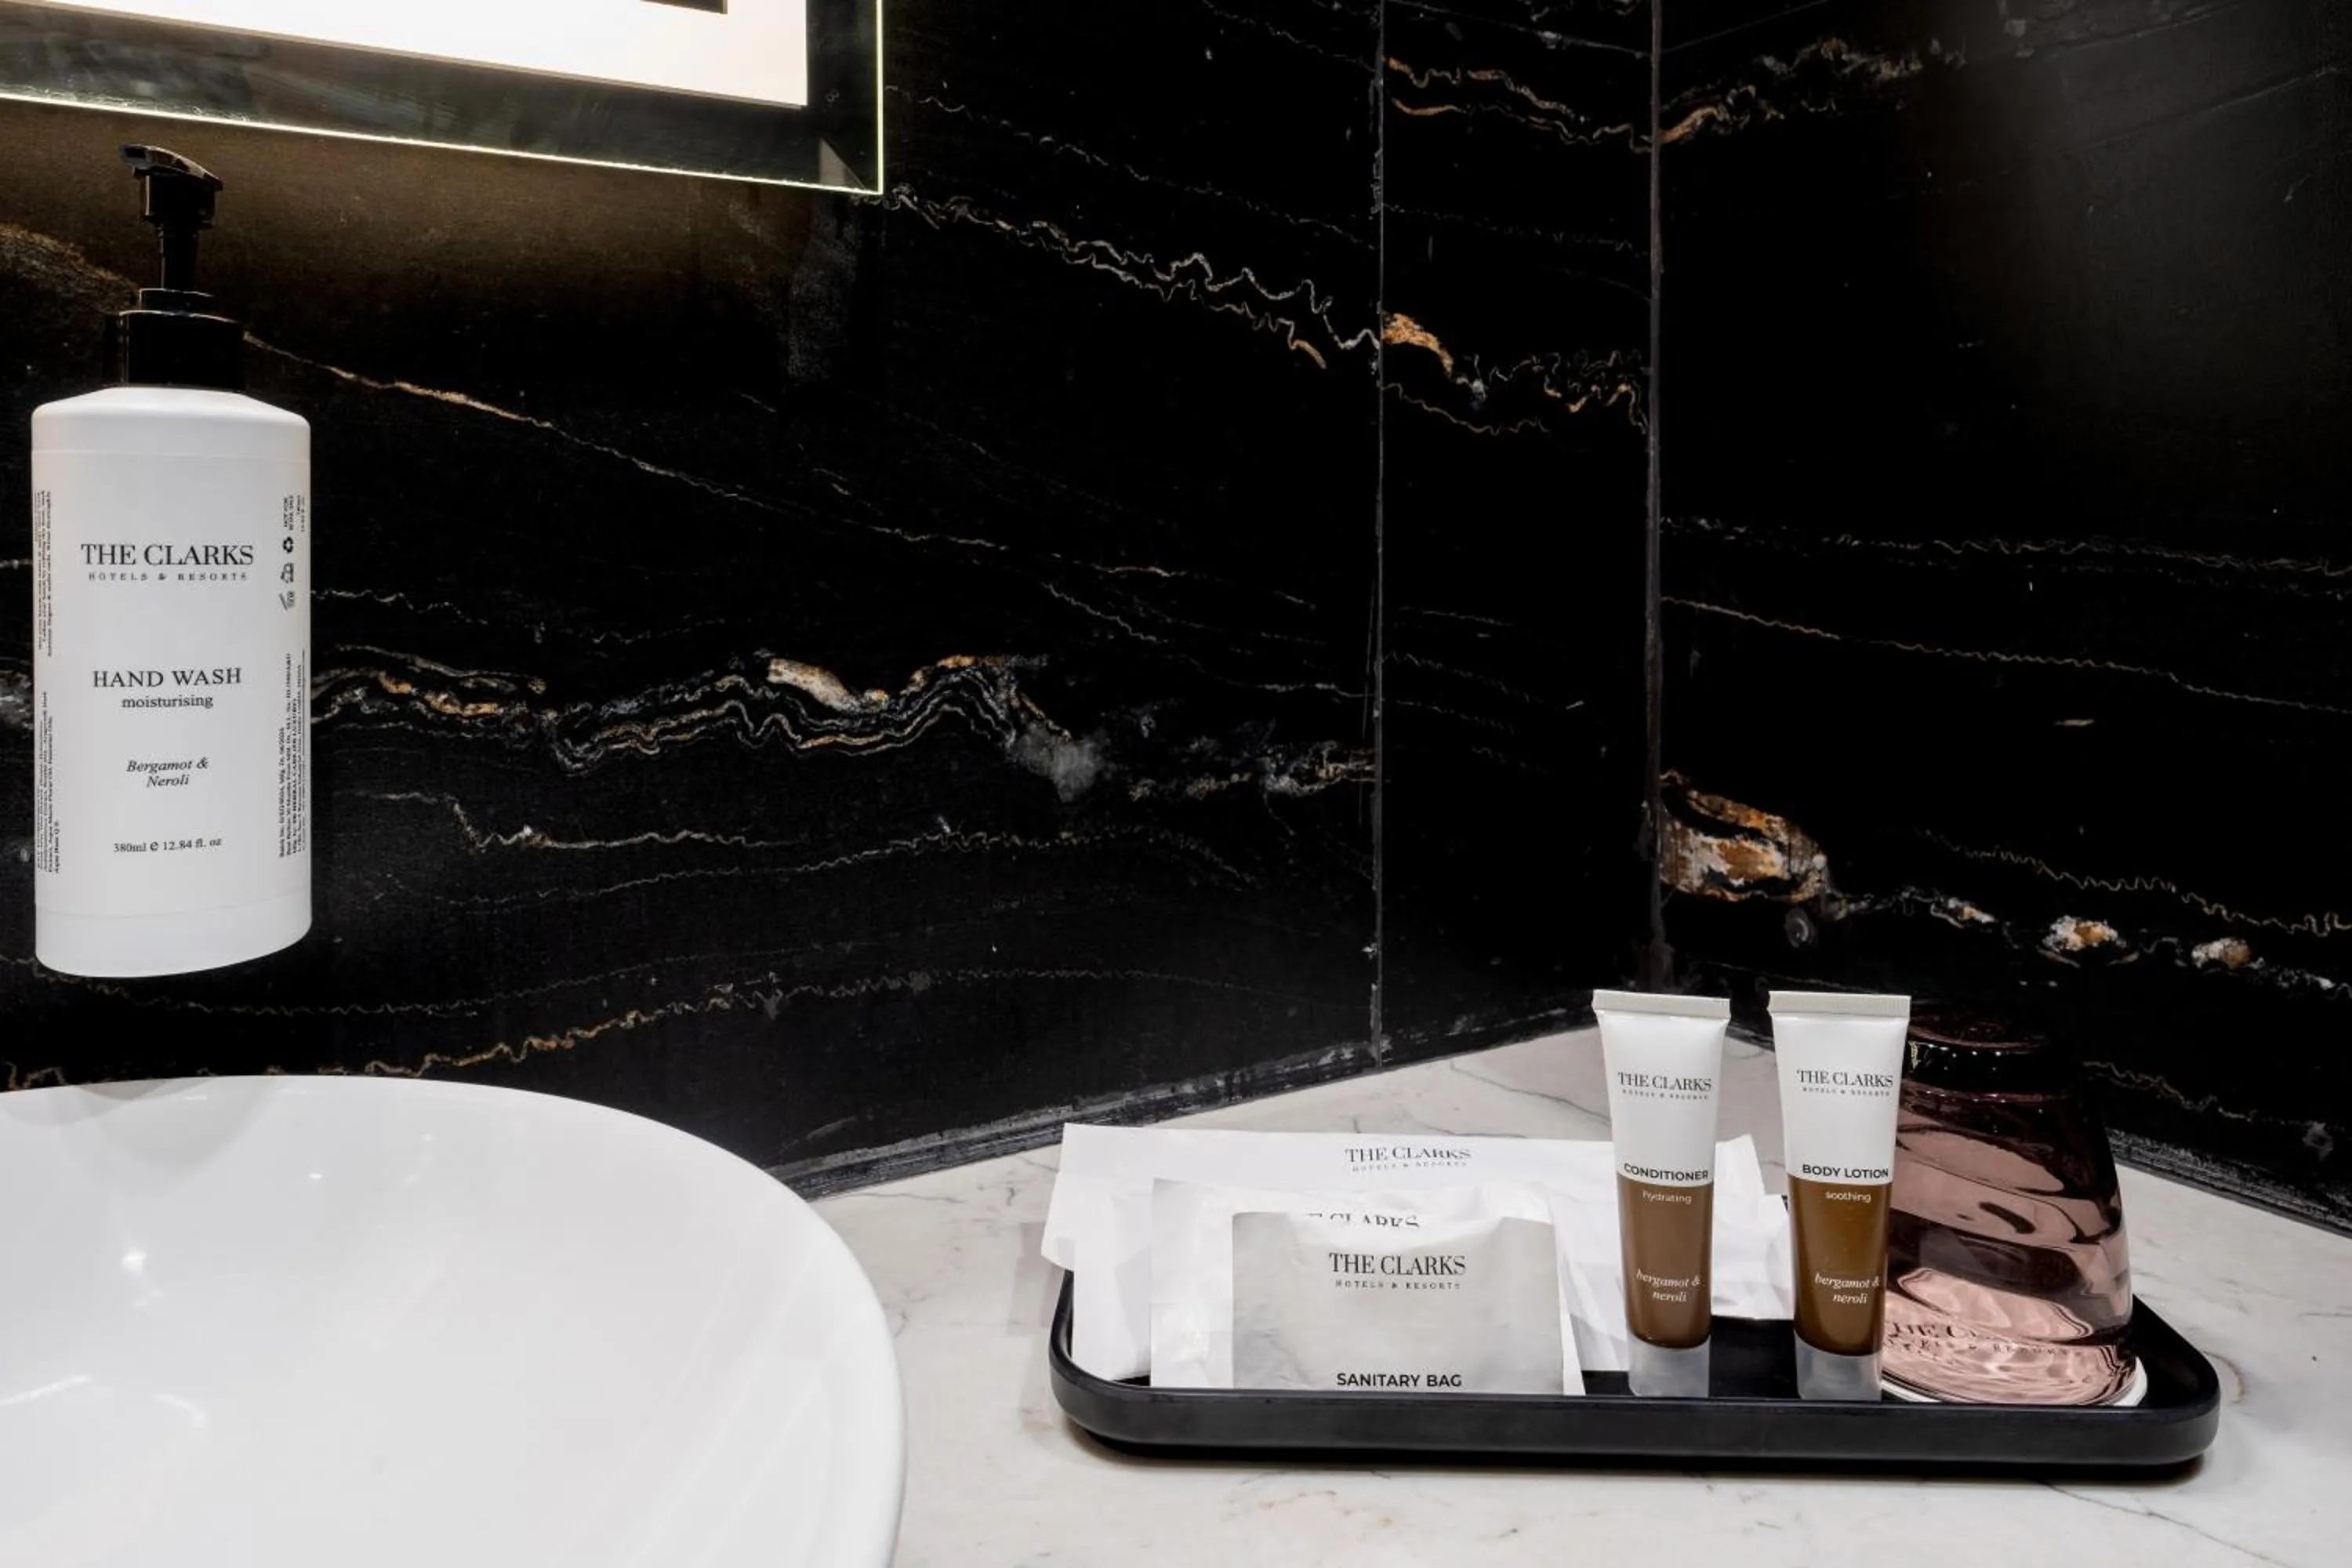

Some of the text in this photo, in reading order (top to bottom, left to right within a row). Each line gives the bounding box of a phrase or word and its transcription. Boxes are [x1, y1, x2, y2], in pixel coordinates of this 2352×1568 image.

[81, 543, 254, 566] THE CLARKS
[89, 572, 247, 581] HOTELS & RESORTS
[93, 667, 241, 688] HAND WASH
[122, 694, 214, 710] moisturising
[126, 757, 209, 774] Bergamot &
[147, 774, 191, 788] Neroli
[113, 841, 147, 853] 380ml
[1618, 1071, 1712, 1091] THE CLARKS
[1796, 1069, 1893, 1087] THE CLARKS
[1345, 1146, 1472, 1163] THE CLARKS
[1624, 1163, 1709, 1181] CONDITIONER
[1802, 1164, 1889, 1178] BODY LOTION
[1642, 1190, 1693, 1205] hydrating
[1826, 1191, 1872, 1203] soothing
[1329, 1253, 1467, 1276] THE CLARKS
[1636, 1268, 1690, 1288] bergamot
[1814, 1272, 1871, 1290] bergamot
[1652, 1291, 1687, 1302] neroli
[1833, 1292, 1868, 1304] neroli
[1337, 1373, 1463, 1387] SANITARY BAG
